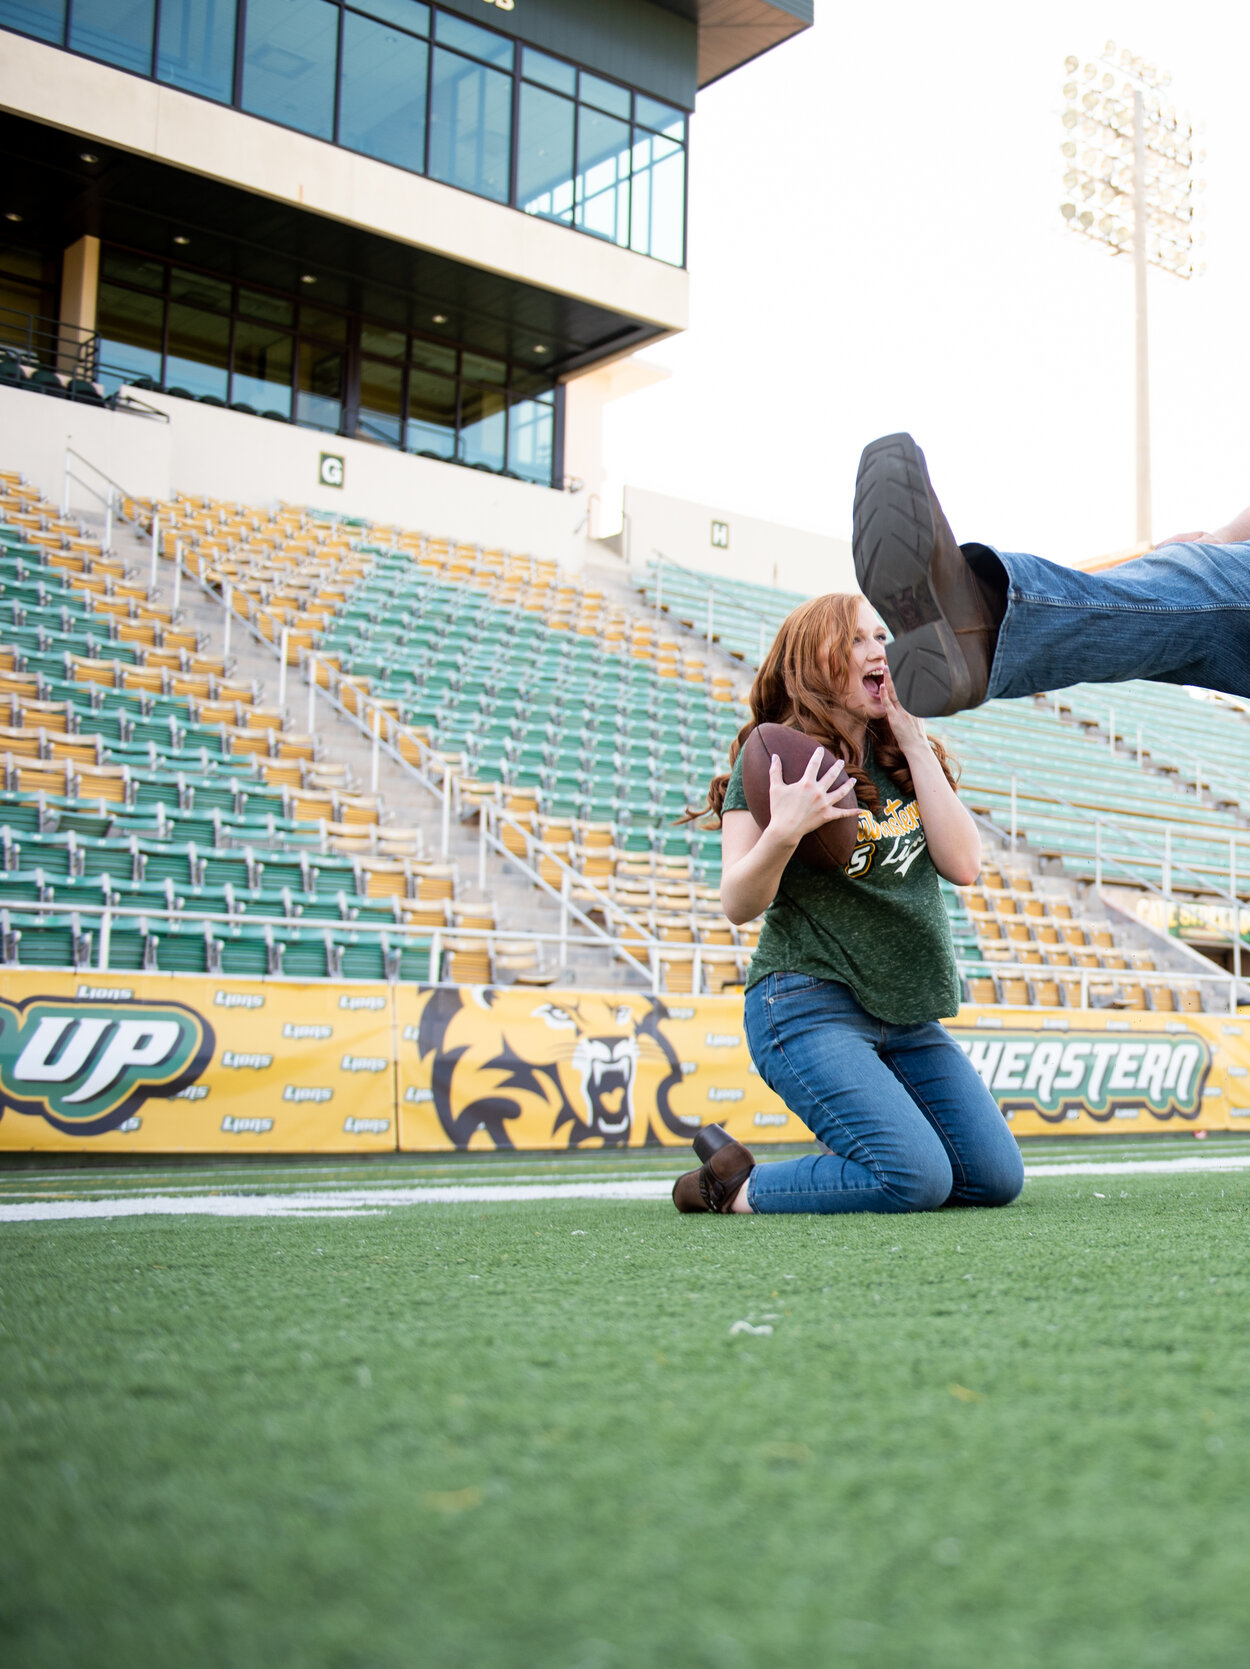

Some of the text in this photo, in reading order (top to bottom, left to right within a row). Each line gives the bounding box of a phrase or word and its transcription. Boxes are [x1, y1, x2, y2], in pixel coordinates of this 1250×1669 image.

[322, 457, 343, 485] G
[713, 522, 728, 547] H
[14, 1016, 182, 1103] UP
